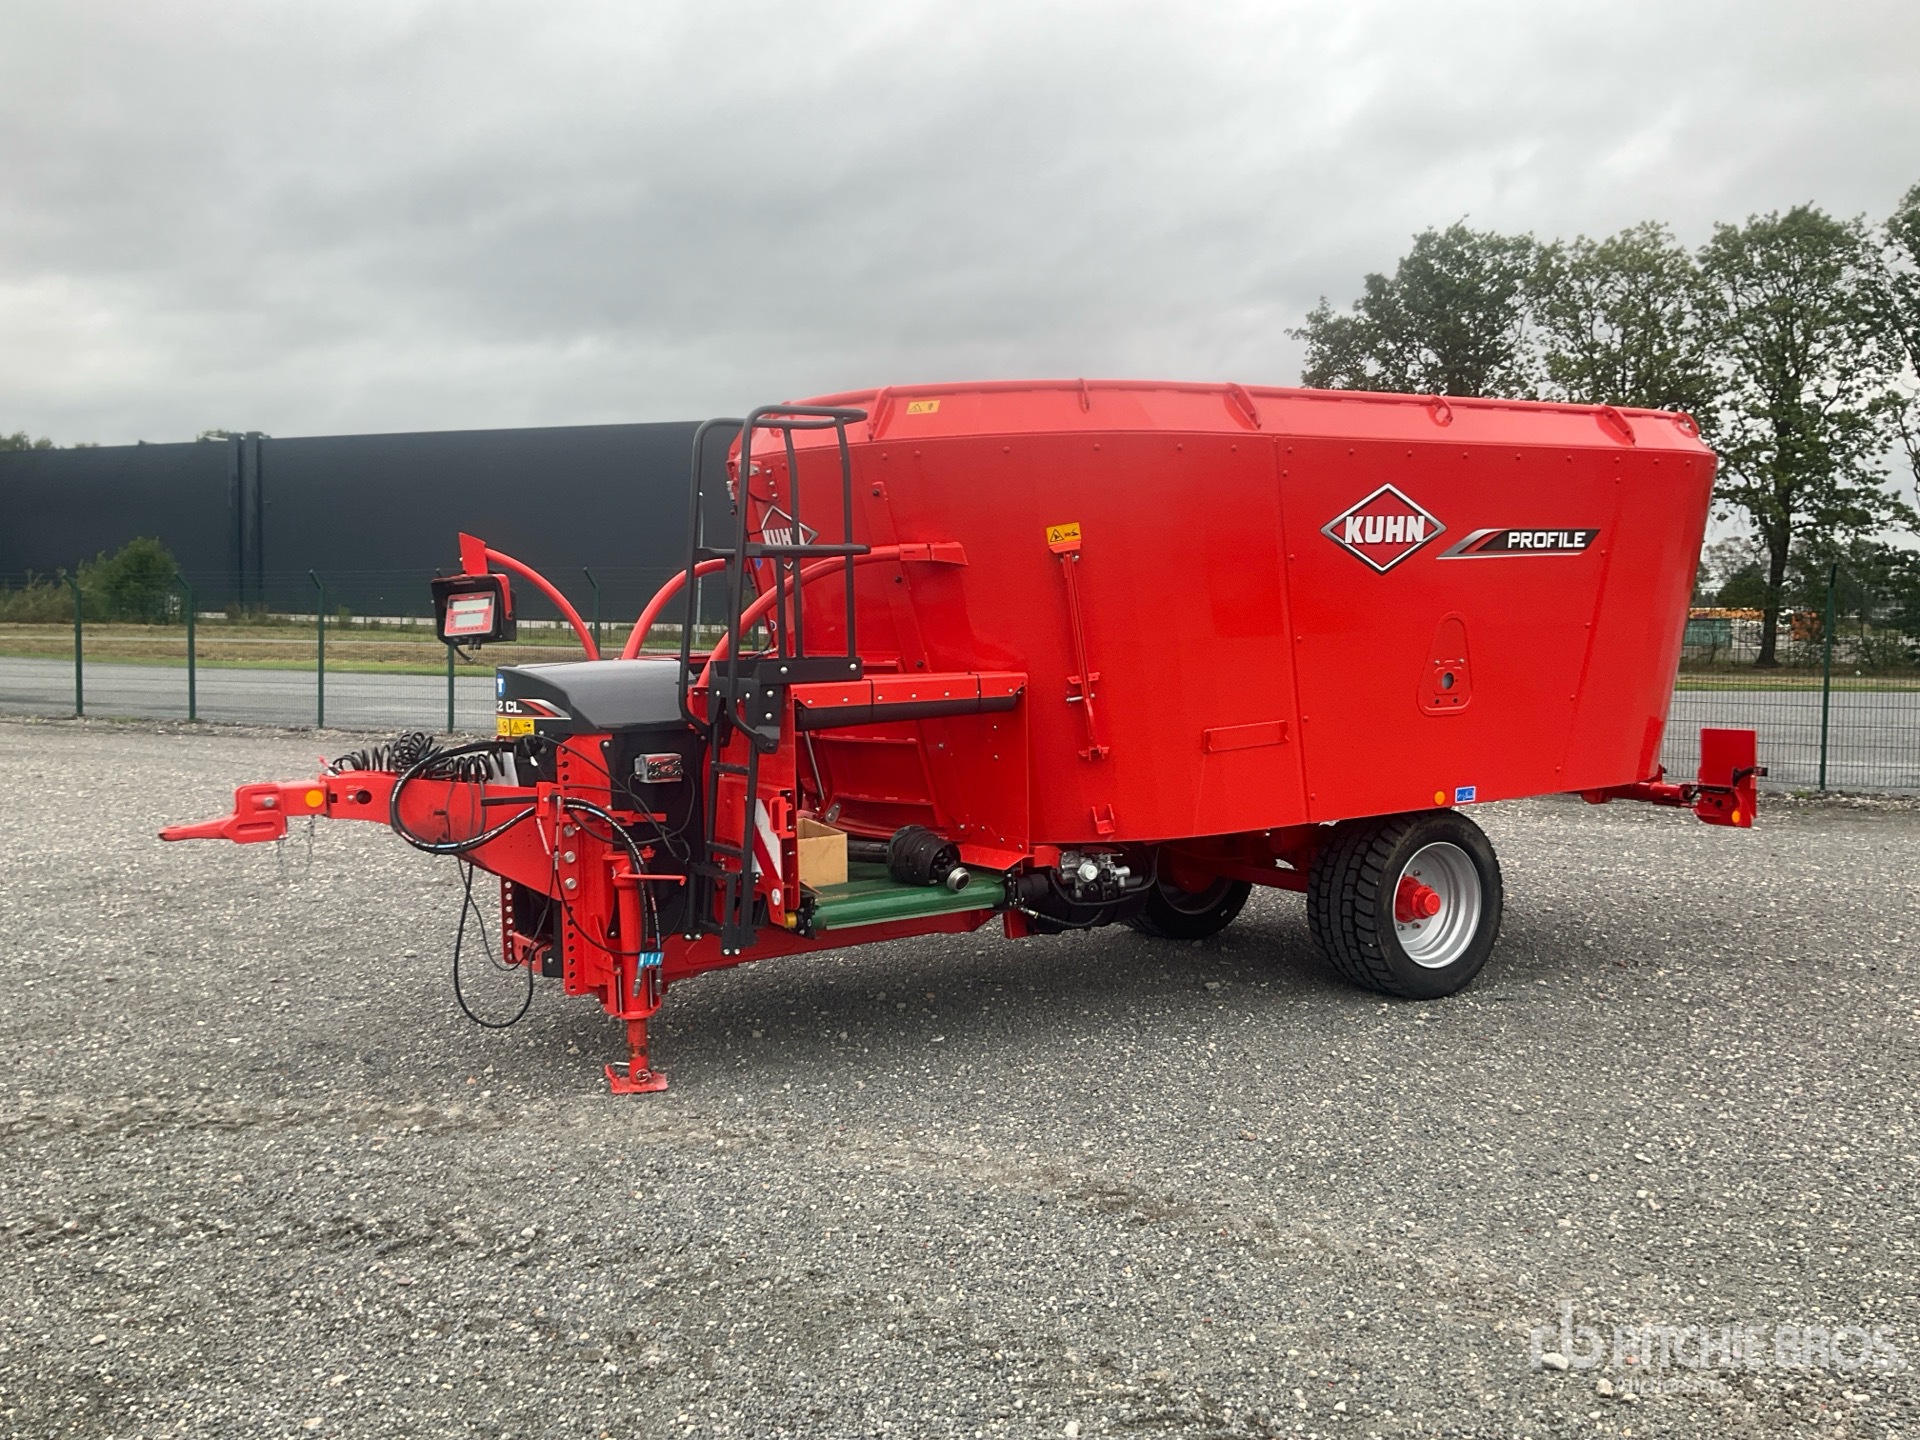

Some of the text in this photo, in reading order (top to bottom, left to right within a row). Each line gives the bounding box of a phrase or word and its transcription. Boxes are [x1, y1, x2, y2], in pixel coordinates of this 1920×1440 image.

[1344, 516, 1425, 544] KUHN
[1507, 531, 1586, 548] PROFILE
[505, 701, 522, 713] CL
